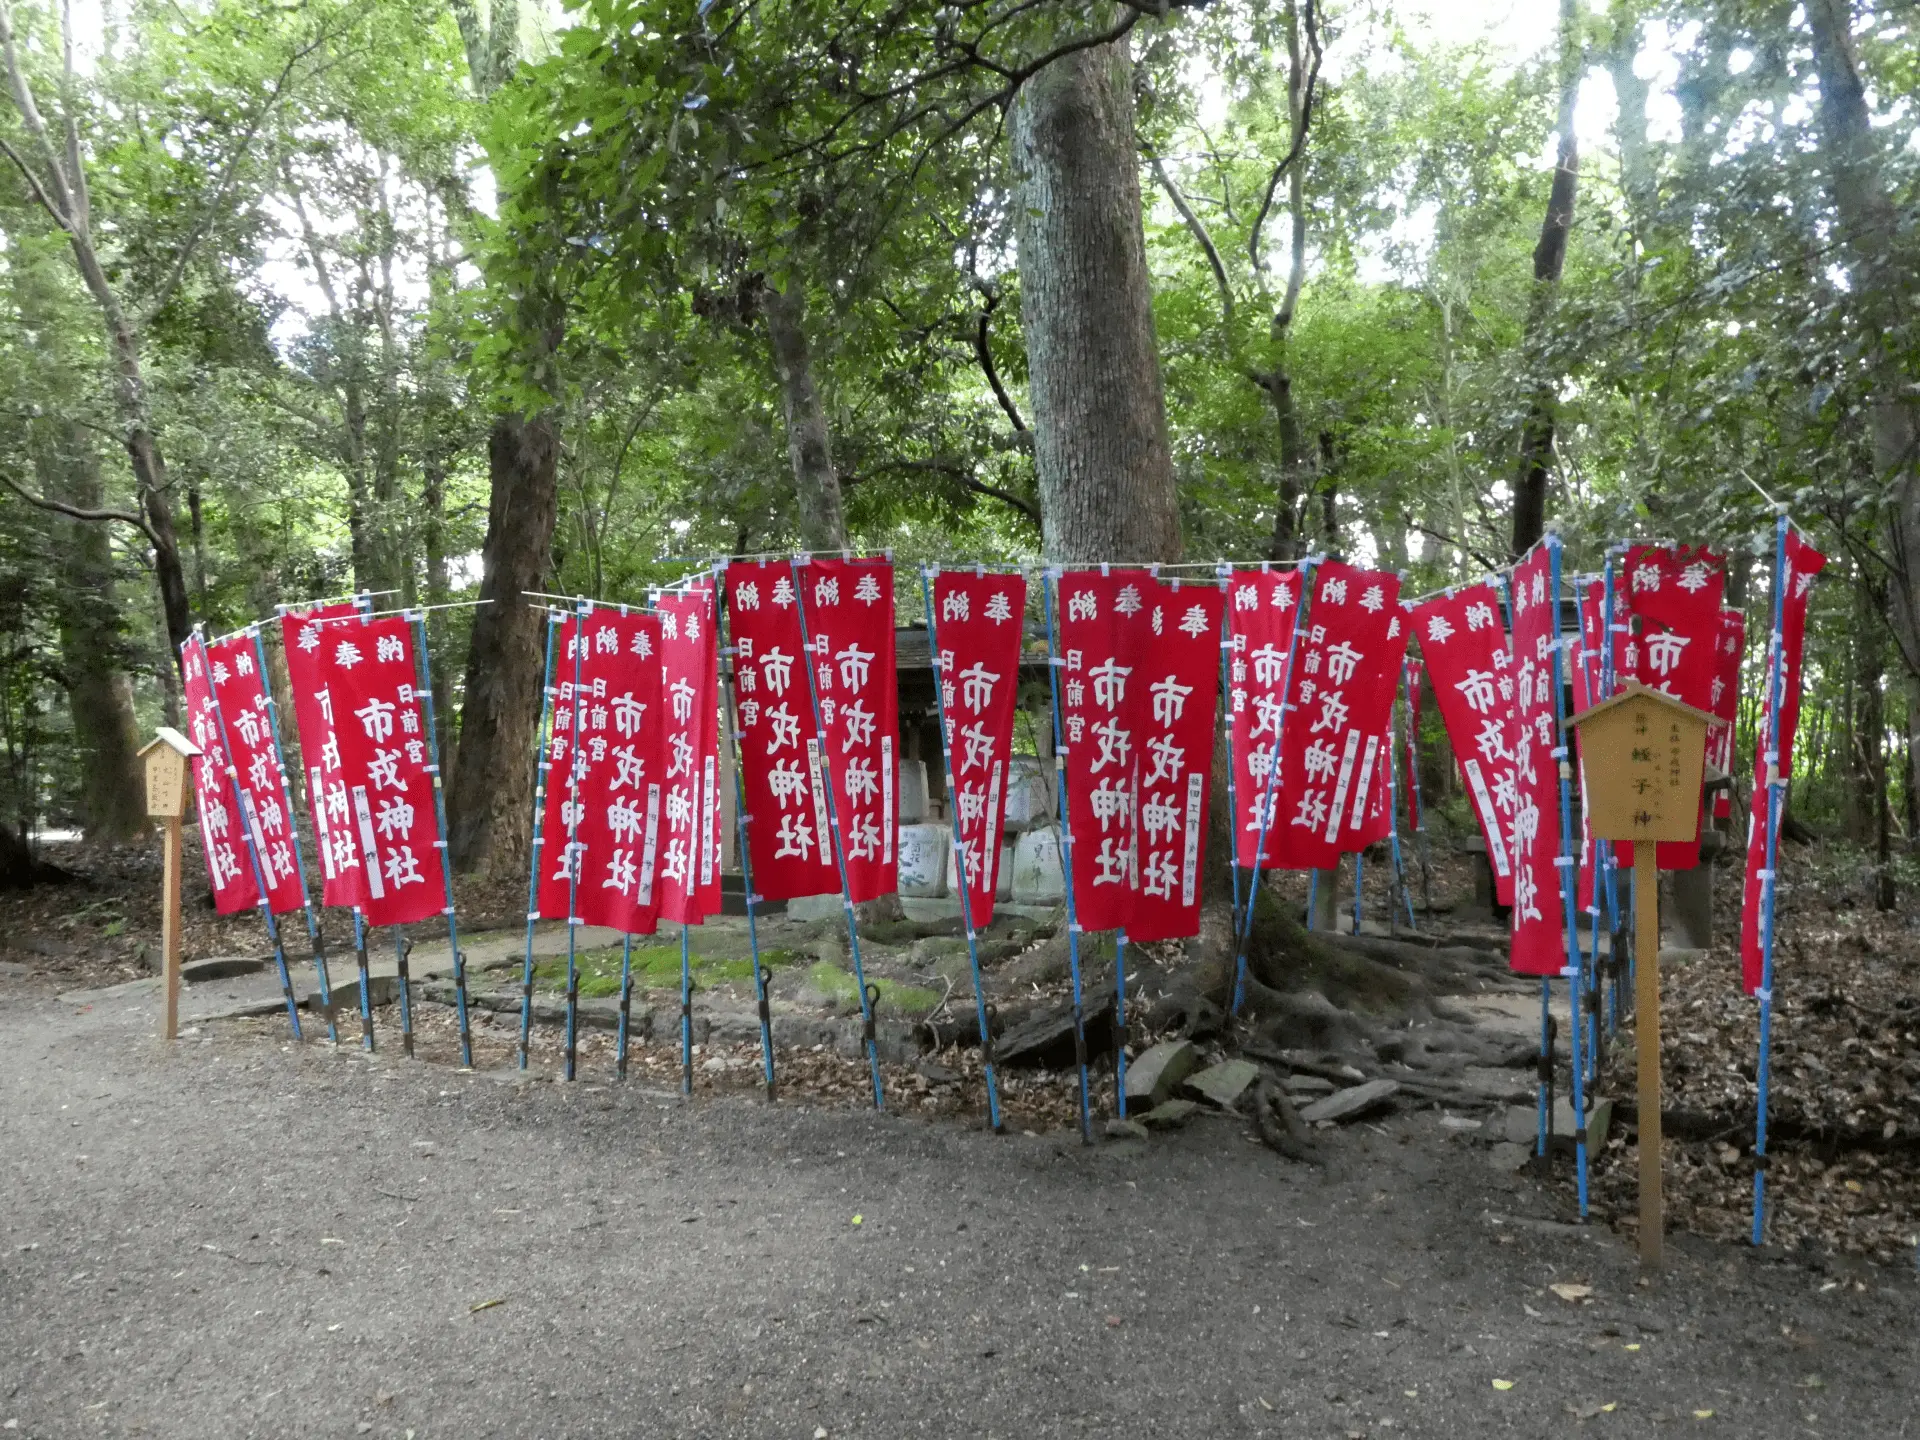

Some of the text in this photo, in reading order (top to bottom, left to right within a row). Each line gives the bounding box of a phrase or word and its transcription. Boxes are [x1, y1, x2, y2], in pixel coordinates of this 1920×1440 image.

[1428, 601, 1495, 643] 奉納
[1516, 569, 1545, 616] 奉納
[213, 651, 254, 686] 奉納
[335, 635, 404, 669] 奉納
[1492, 649, 1514, 719] 日前
[1535, 634, 1553, 746] 日前宮
[254, 693, 277, 765] 日前宮
[397, 683, 424, 765] 日前宮
[193, 711, 242, 882] 市戎神社
[233, 709, 294, 880] 市戎神社
[354, 697, 425, 890] 市戎神社
[1514, 656, 1543, 922] 市戎神社
